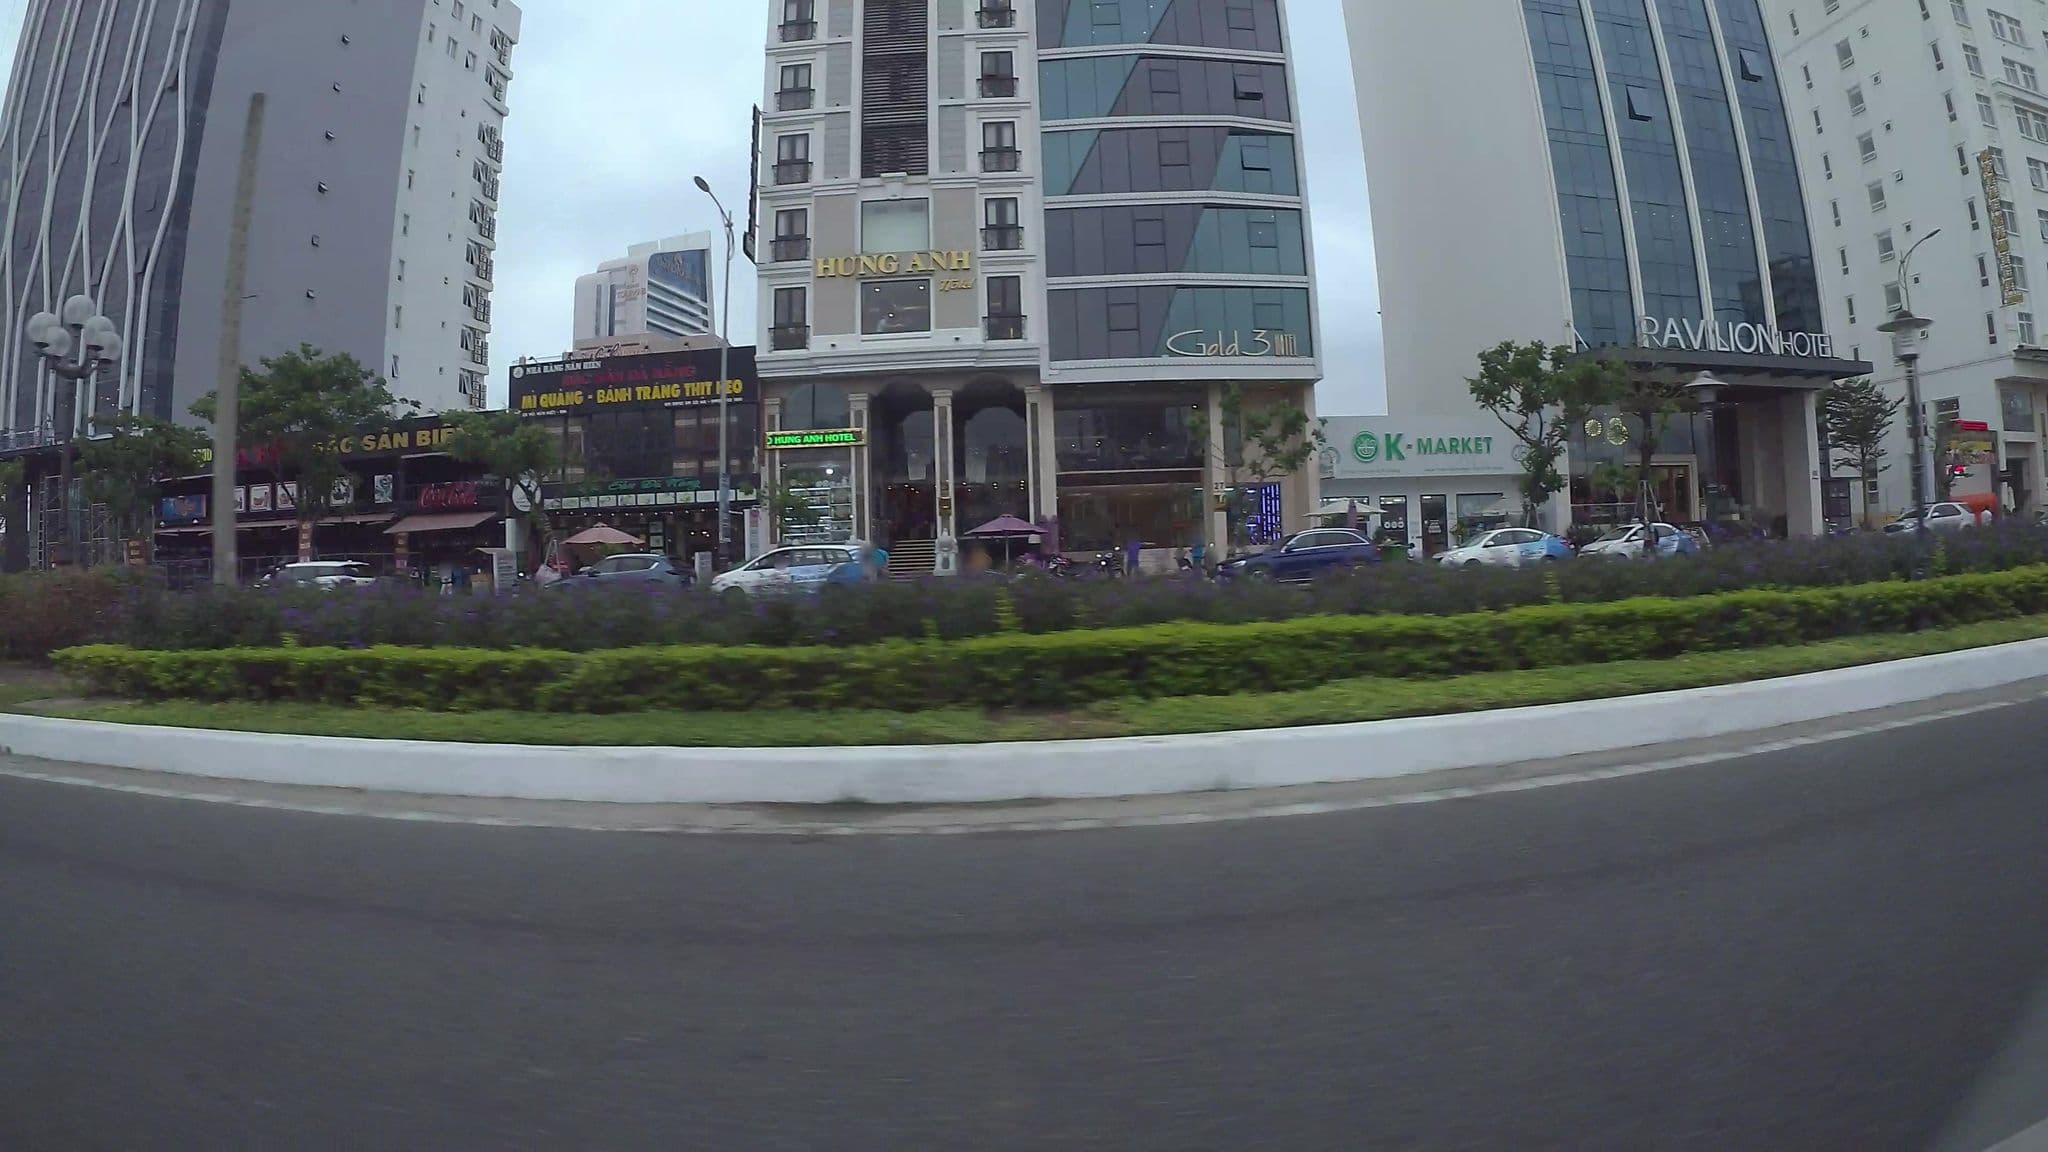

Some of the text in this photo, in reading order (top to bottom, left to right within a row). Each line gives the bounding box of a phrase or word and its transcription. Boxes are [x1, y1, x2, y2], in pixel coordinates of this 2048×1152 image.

[816, 250, 971, 278] HUNG ANH
[1166, 329, 1239, 357] Gold
[1241, 329, 1271, 356] 3
[803, 434, 823, 443] ANH
[825, 433, 856, 443] HOTEL
